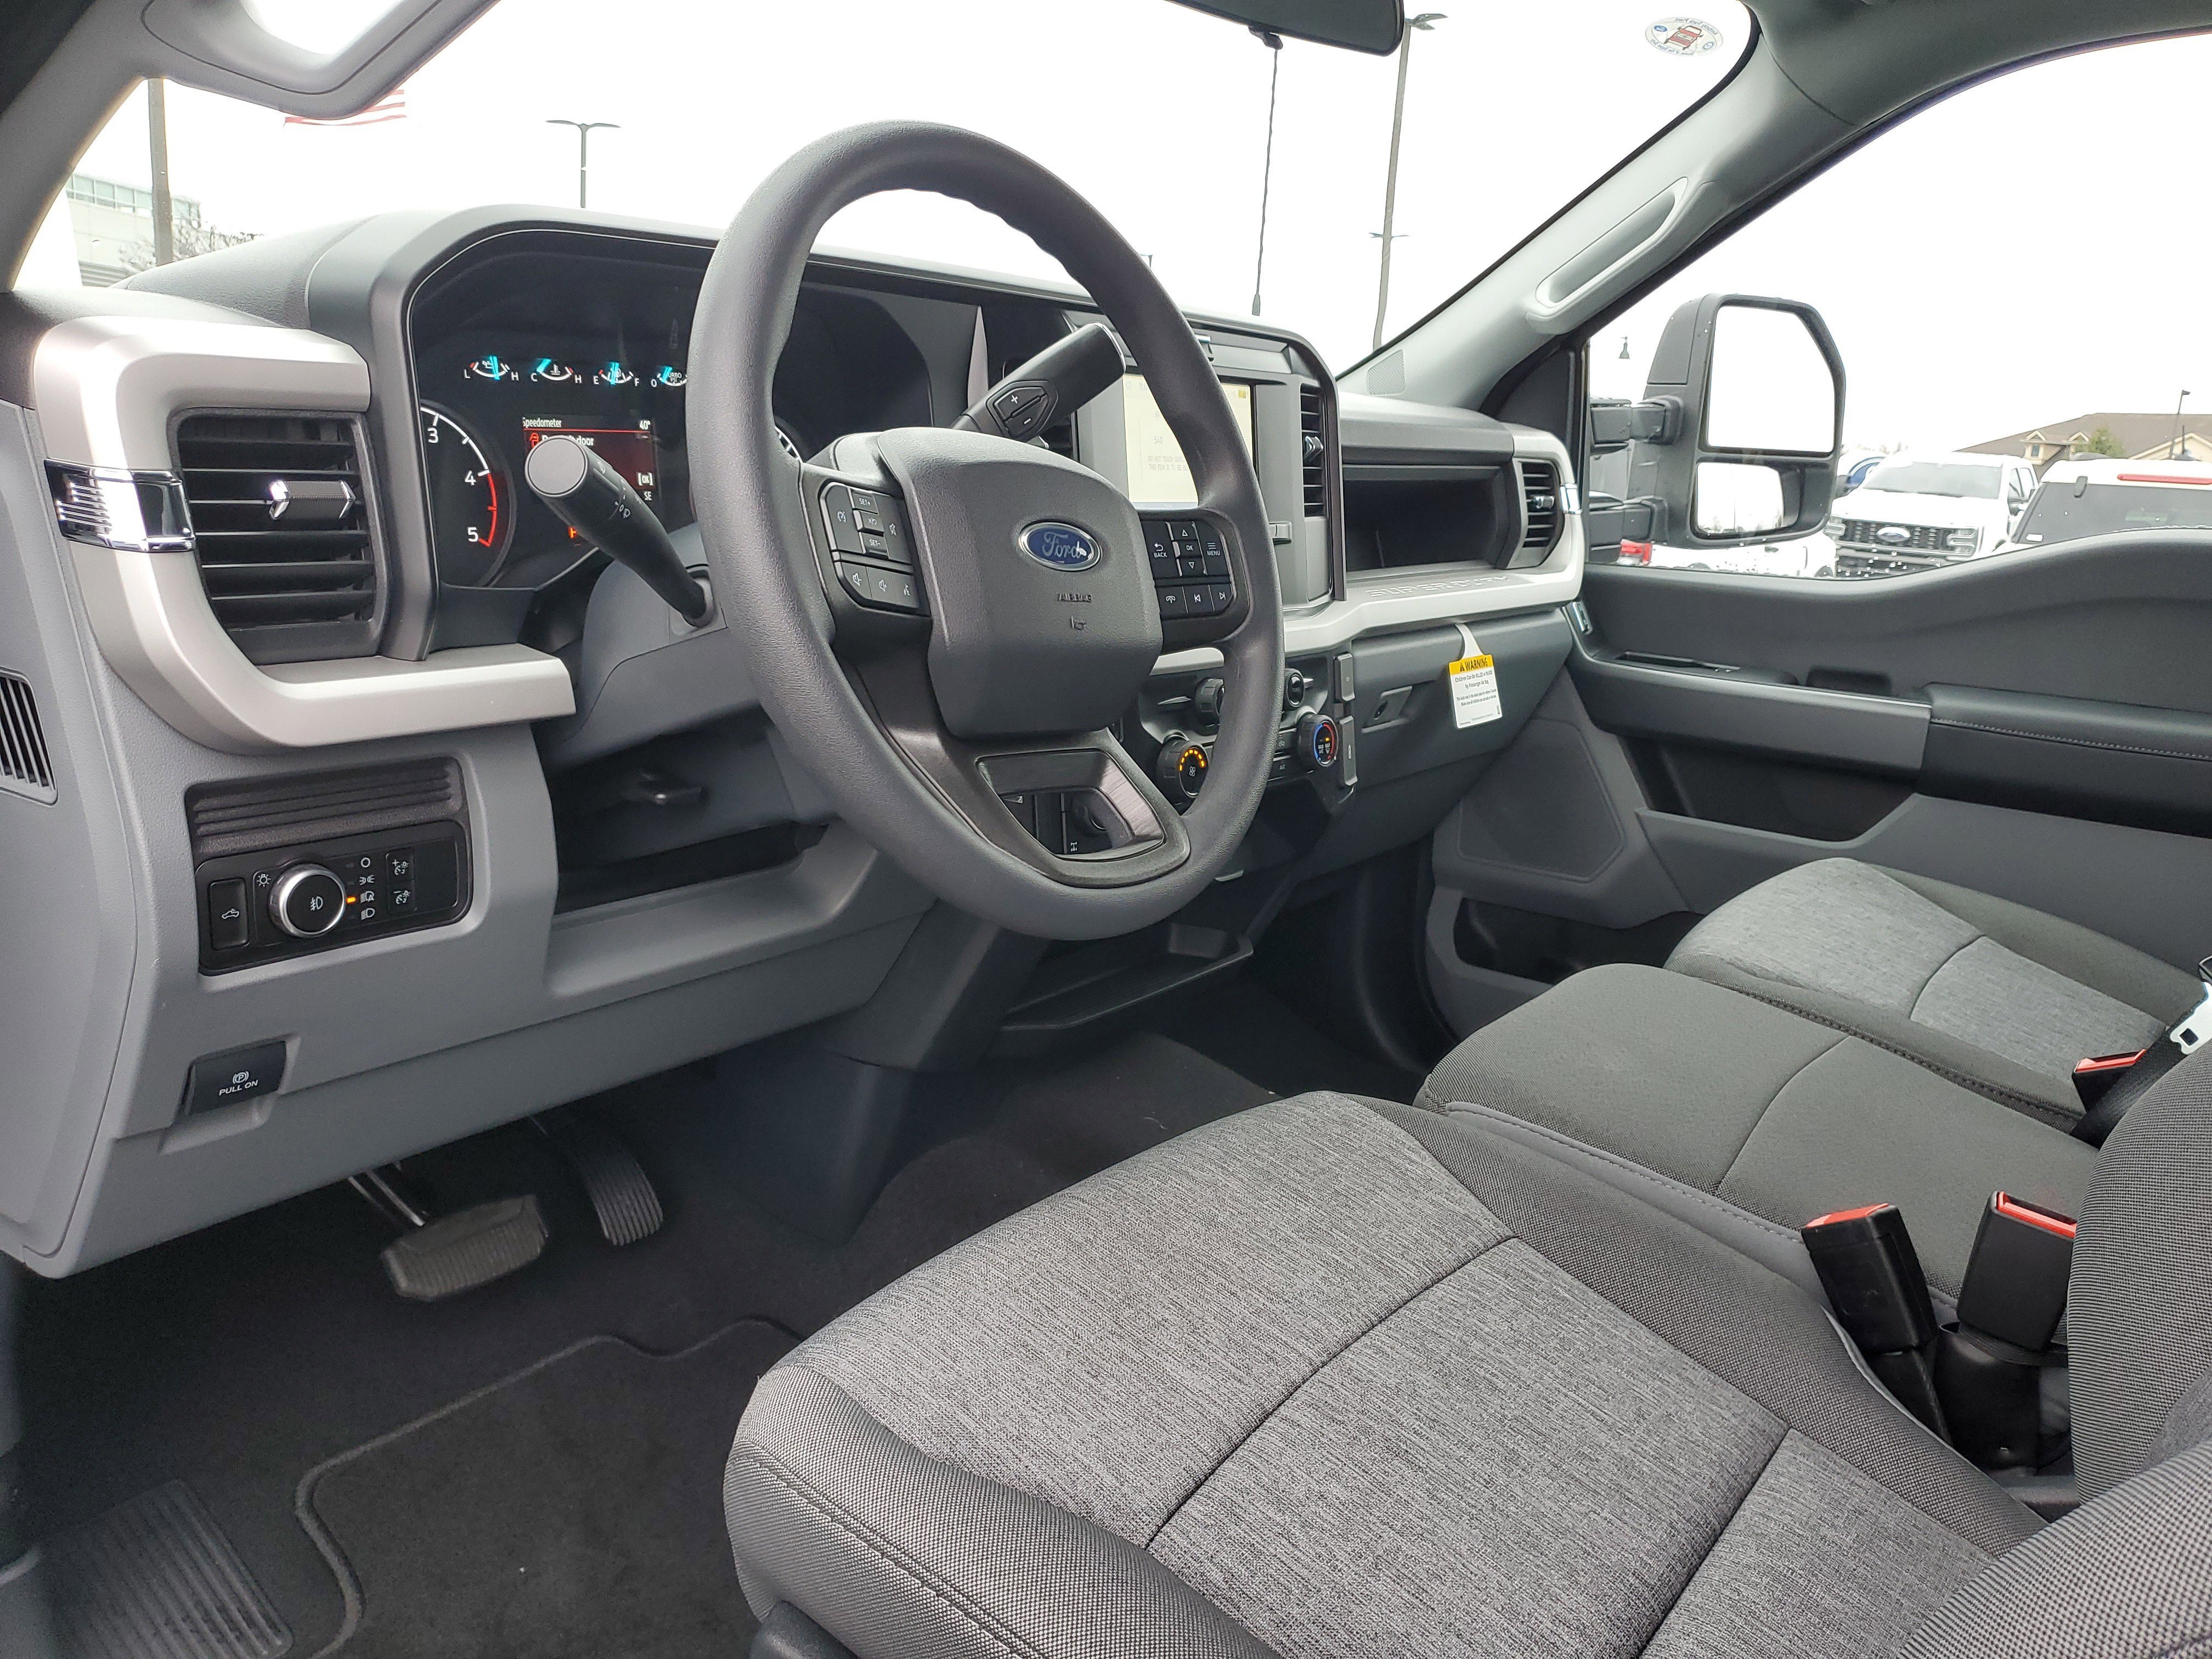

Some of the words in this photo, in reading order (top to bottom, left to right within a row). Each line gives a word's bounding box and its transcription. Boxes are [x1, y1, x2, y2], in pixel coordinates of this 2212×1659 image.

[464, 369, 471, 379] L
[511, 371, 519, 381] H
[531, 373, 538, 382] C
[574, 375, 582, 384] H
[593, 376, 599, 385] E
[635, 378, 640, 387] F
[522, 417, 562, 428] Speedometer
[428, 428, 438, 444] 3
[465, 471, 476, 486] 4
[467, 527, 478, 542] 5
[1042, 532, 1081, 558] Ford
[1464, 657, 1488, 671] WARNING
[219, 1085, 242, 1096] PULL
[244, 1079, 258, 1089] ON
